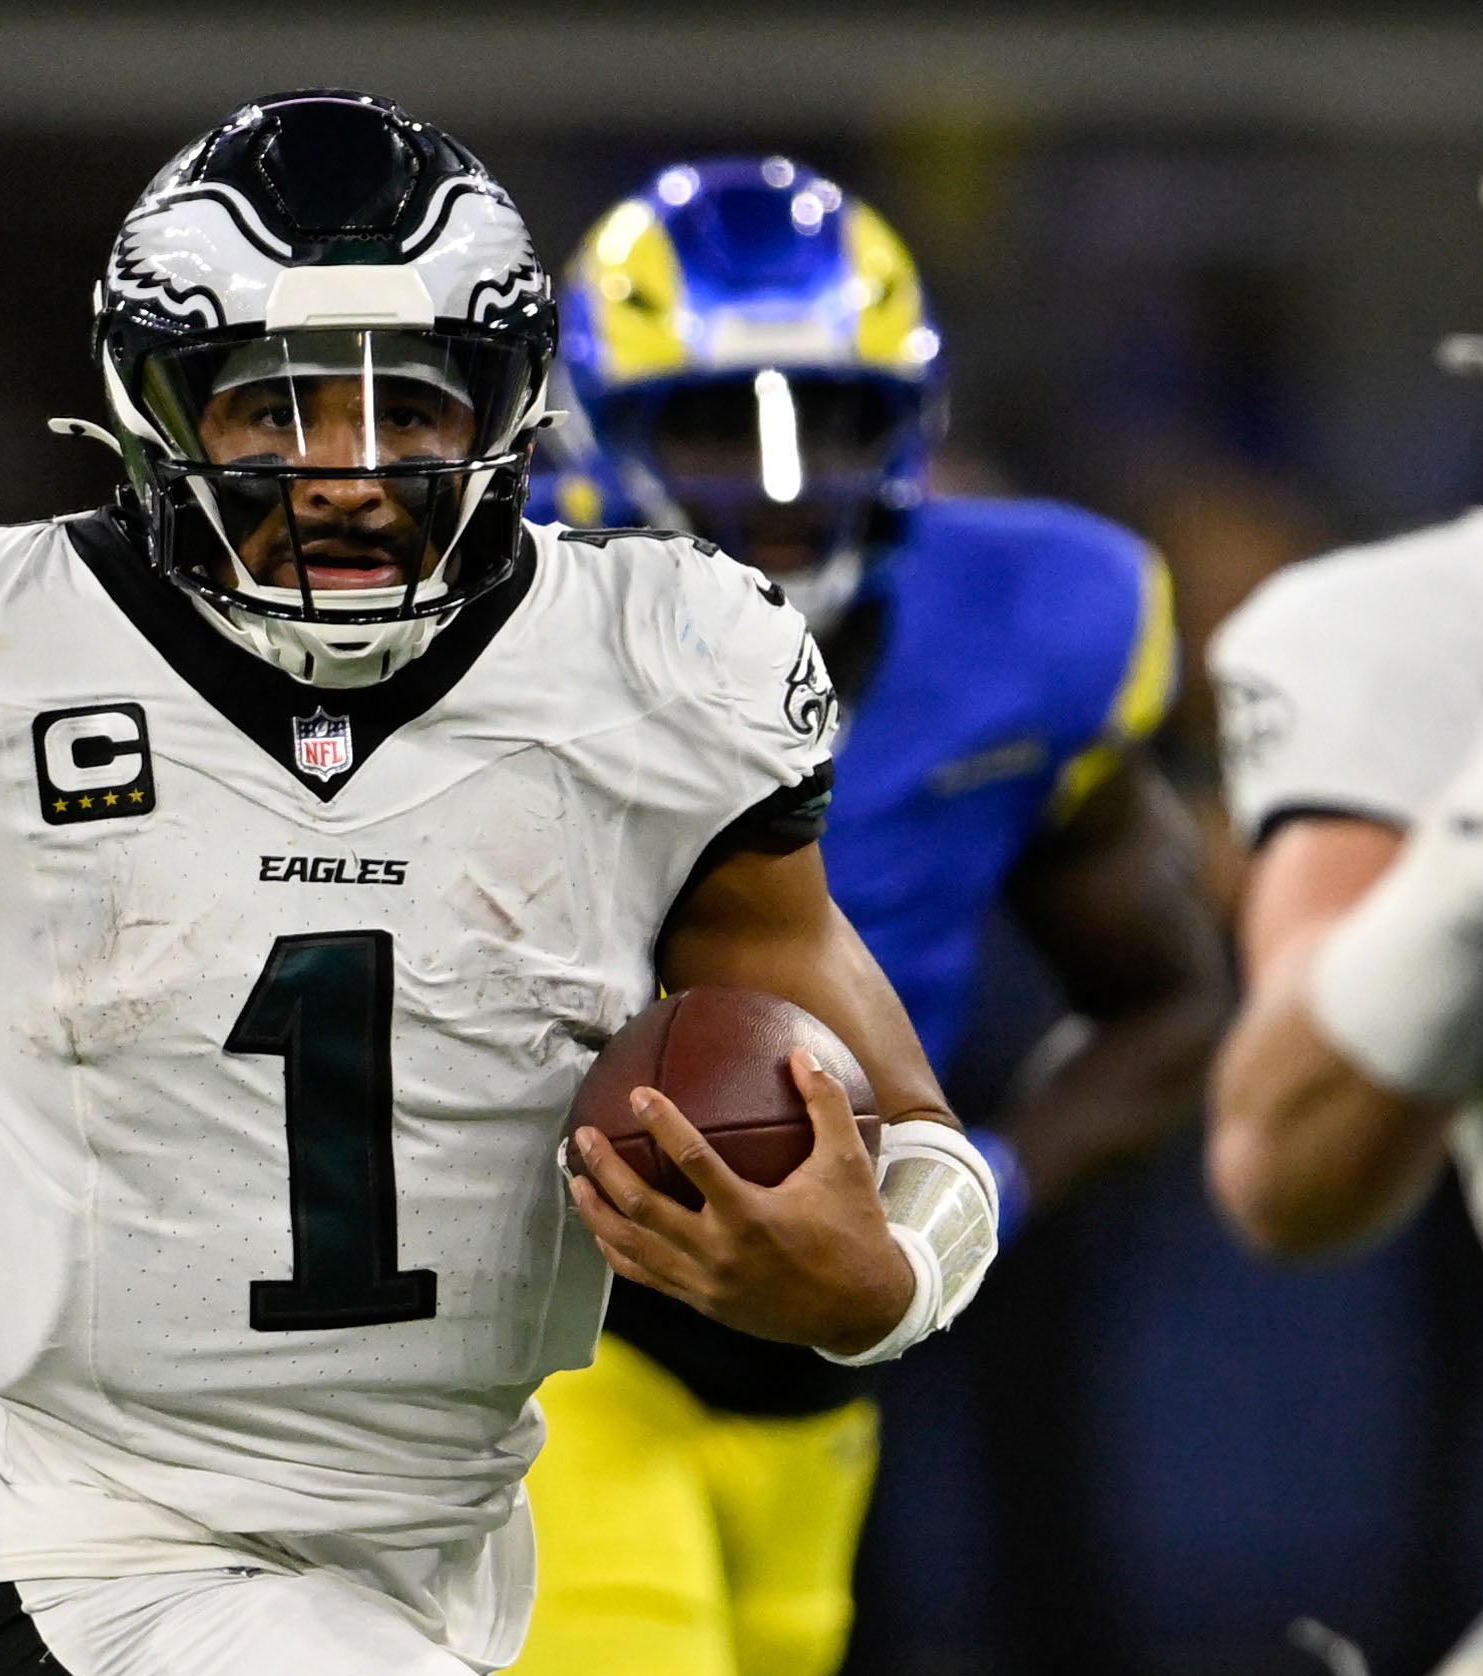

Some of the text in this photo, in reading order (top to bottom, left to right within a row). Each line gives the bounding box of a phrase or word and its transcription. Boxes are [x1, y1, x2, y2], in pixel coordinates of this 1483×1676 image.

[44, 711, 143, 792] C
[304, 741, 343, 767] NFL
[259, 856, 409, 885] EAGLES
[224, 929, 437, 1332] 1
